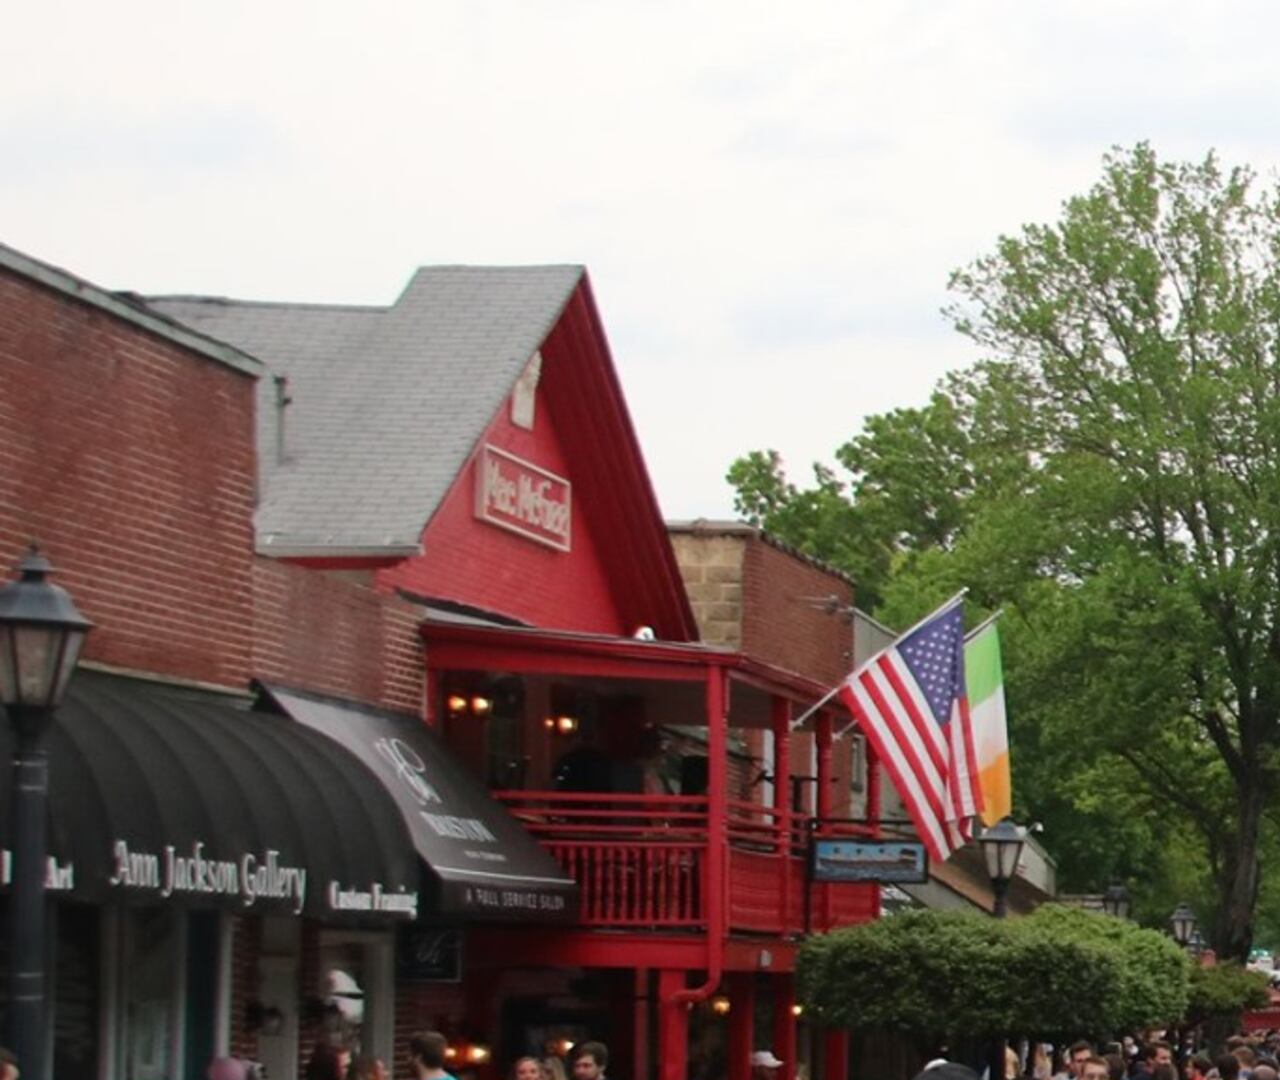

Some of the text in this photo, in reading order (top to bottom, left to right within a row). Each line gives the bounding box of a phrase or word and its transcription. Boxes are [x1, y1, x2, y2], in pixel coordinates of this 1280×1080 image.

[110, 840, 306, 914] Ann Jackson Gallery
